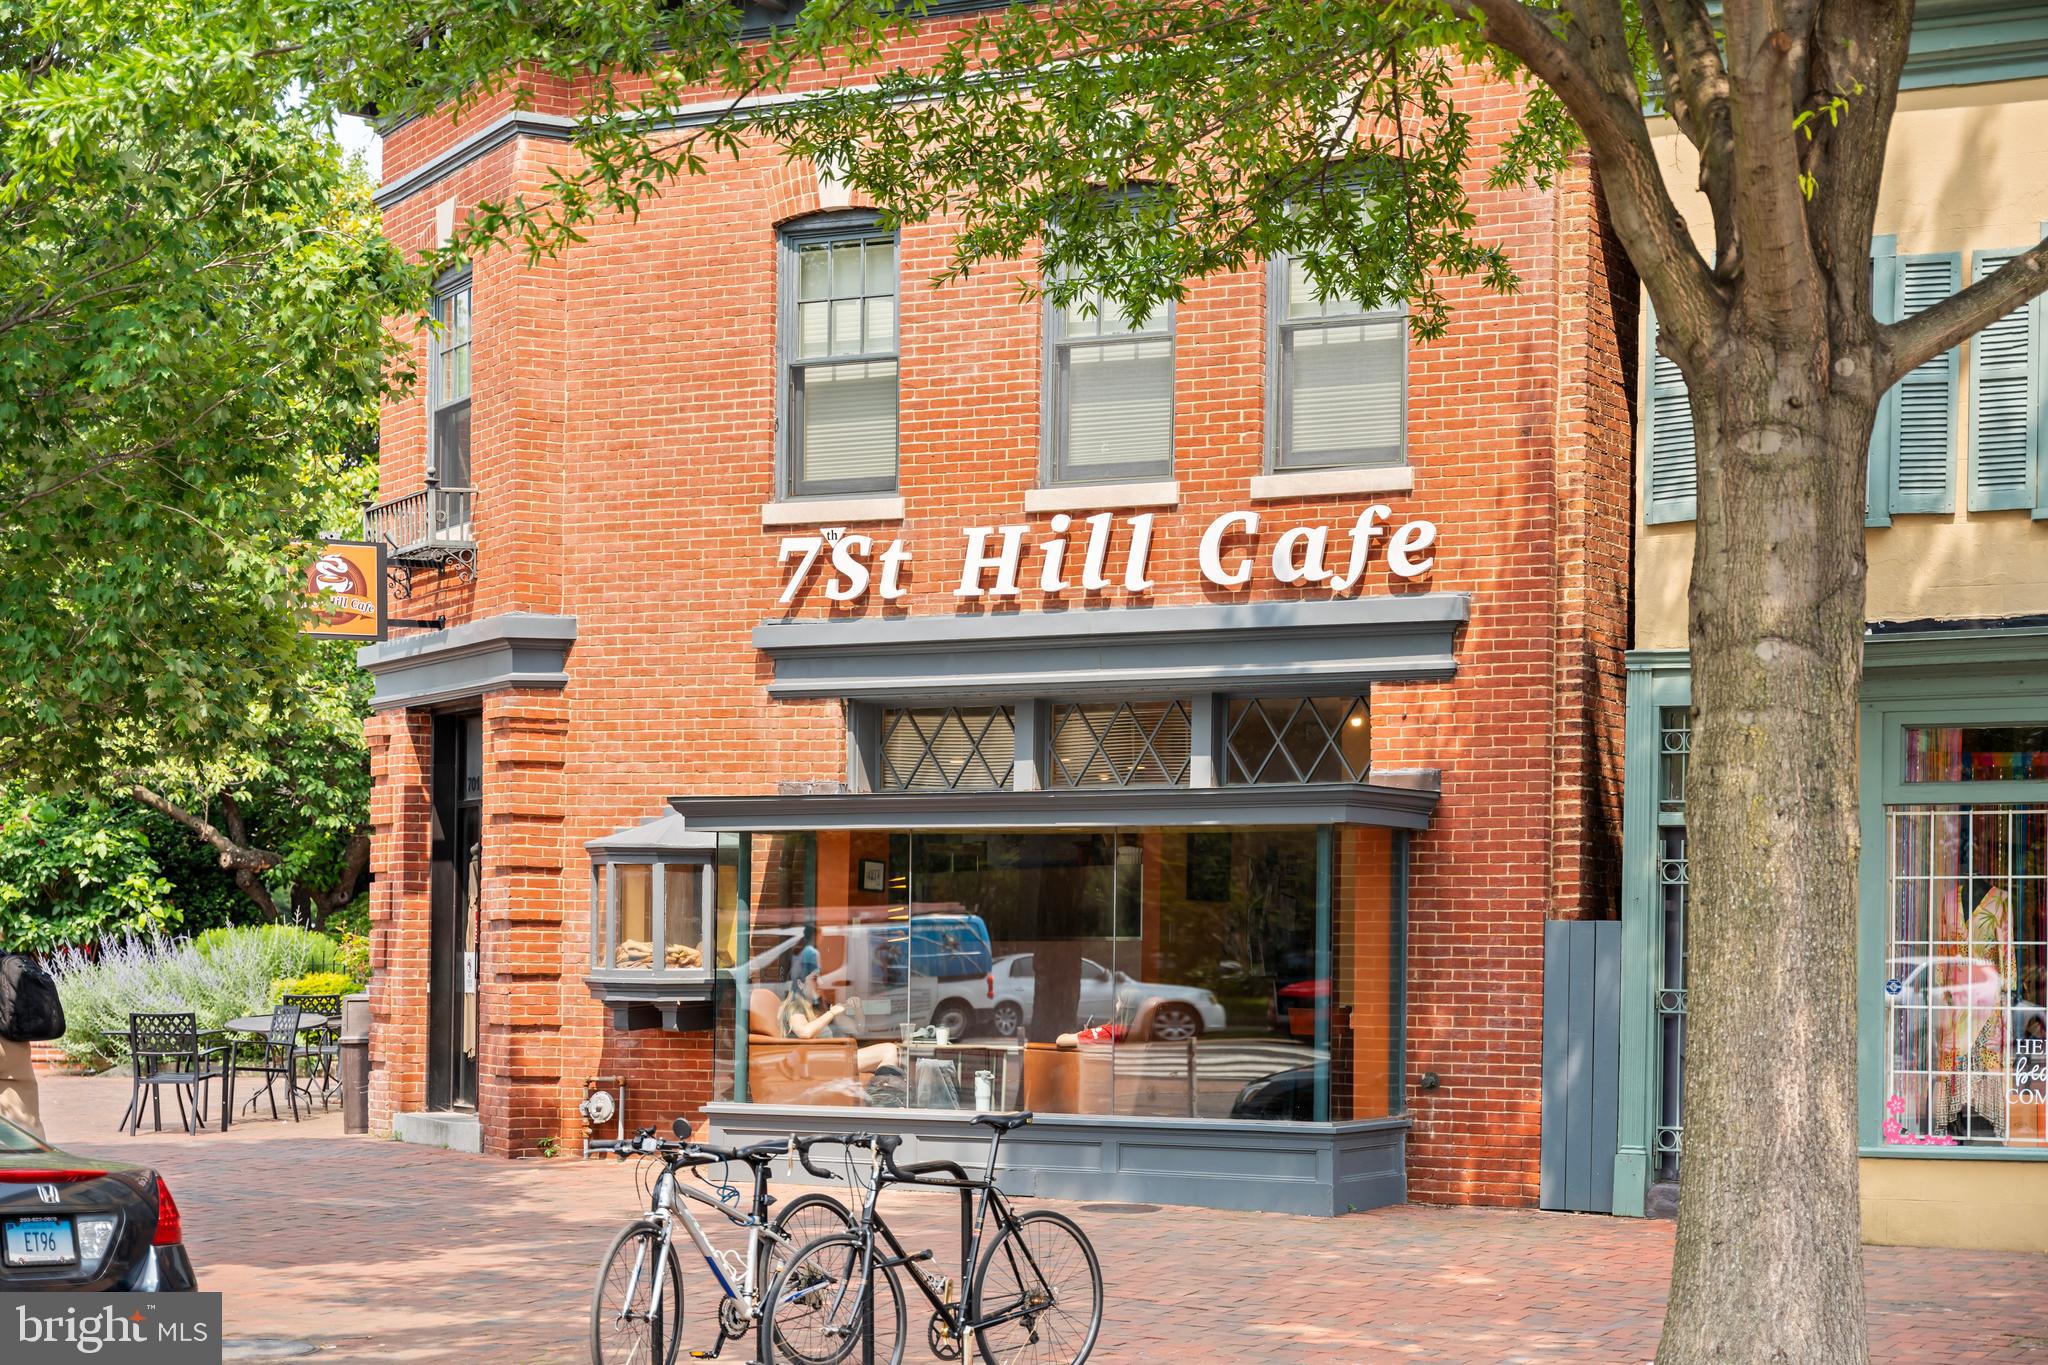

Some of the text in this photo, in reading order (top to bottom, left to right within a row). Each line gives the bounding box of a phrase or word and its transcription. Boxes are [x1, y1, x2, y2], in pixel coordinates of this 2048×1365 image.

[954, 512, 1156, 598] Hill
[1198, 504, 1437, 592] Cafe
[351, 598, 375, 613] Cafe
[467, 776, 480, 792] 701
[23, 1231, 57, 1253] ET96
